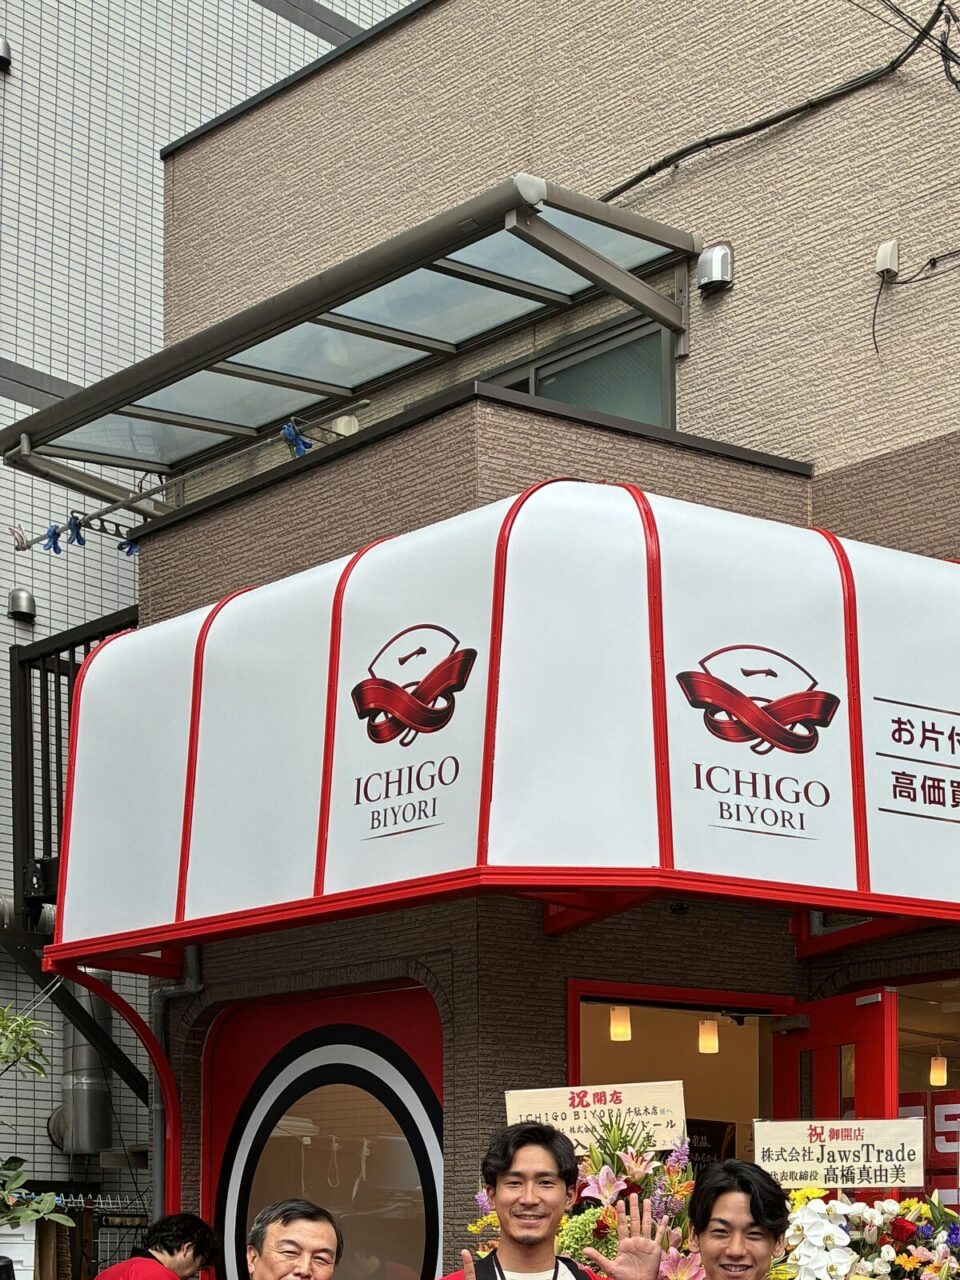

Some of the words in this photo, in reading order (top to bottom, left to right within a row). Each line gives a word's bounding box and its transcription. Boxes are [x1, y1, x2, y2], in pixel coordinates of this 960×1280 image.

[354, 755, 460, 807] ICHIGO
[692, 762, 831, 808] ICHIGO
[369, 796, 438, 831] BIYORI
[718, 799, 806, 832] BIYORI
